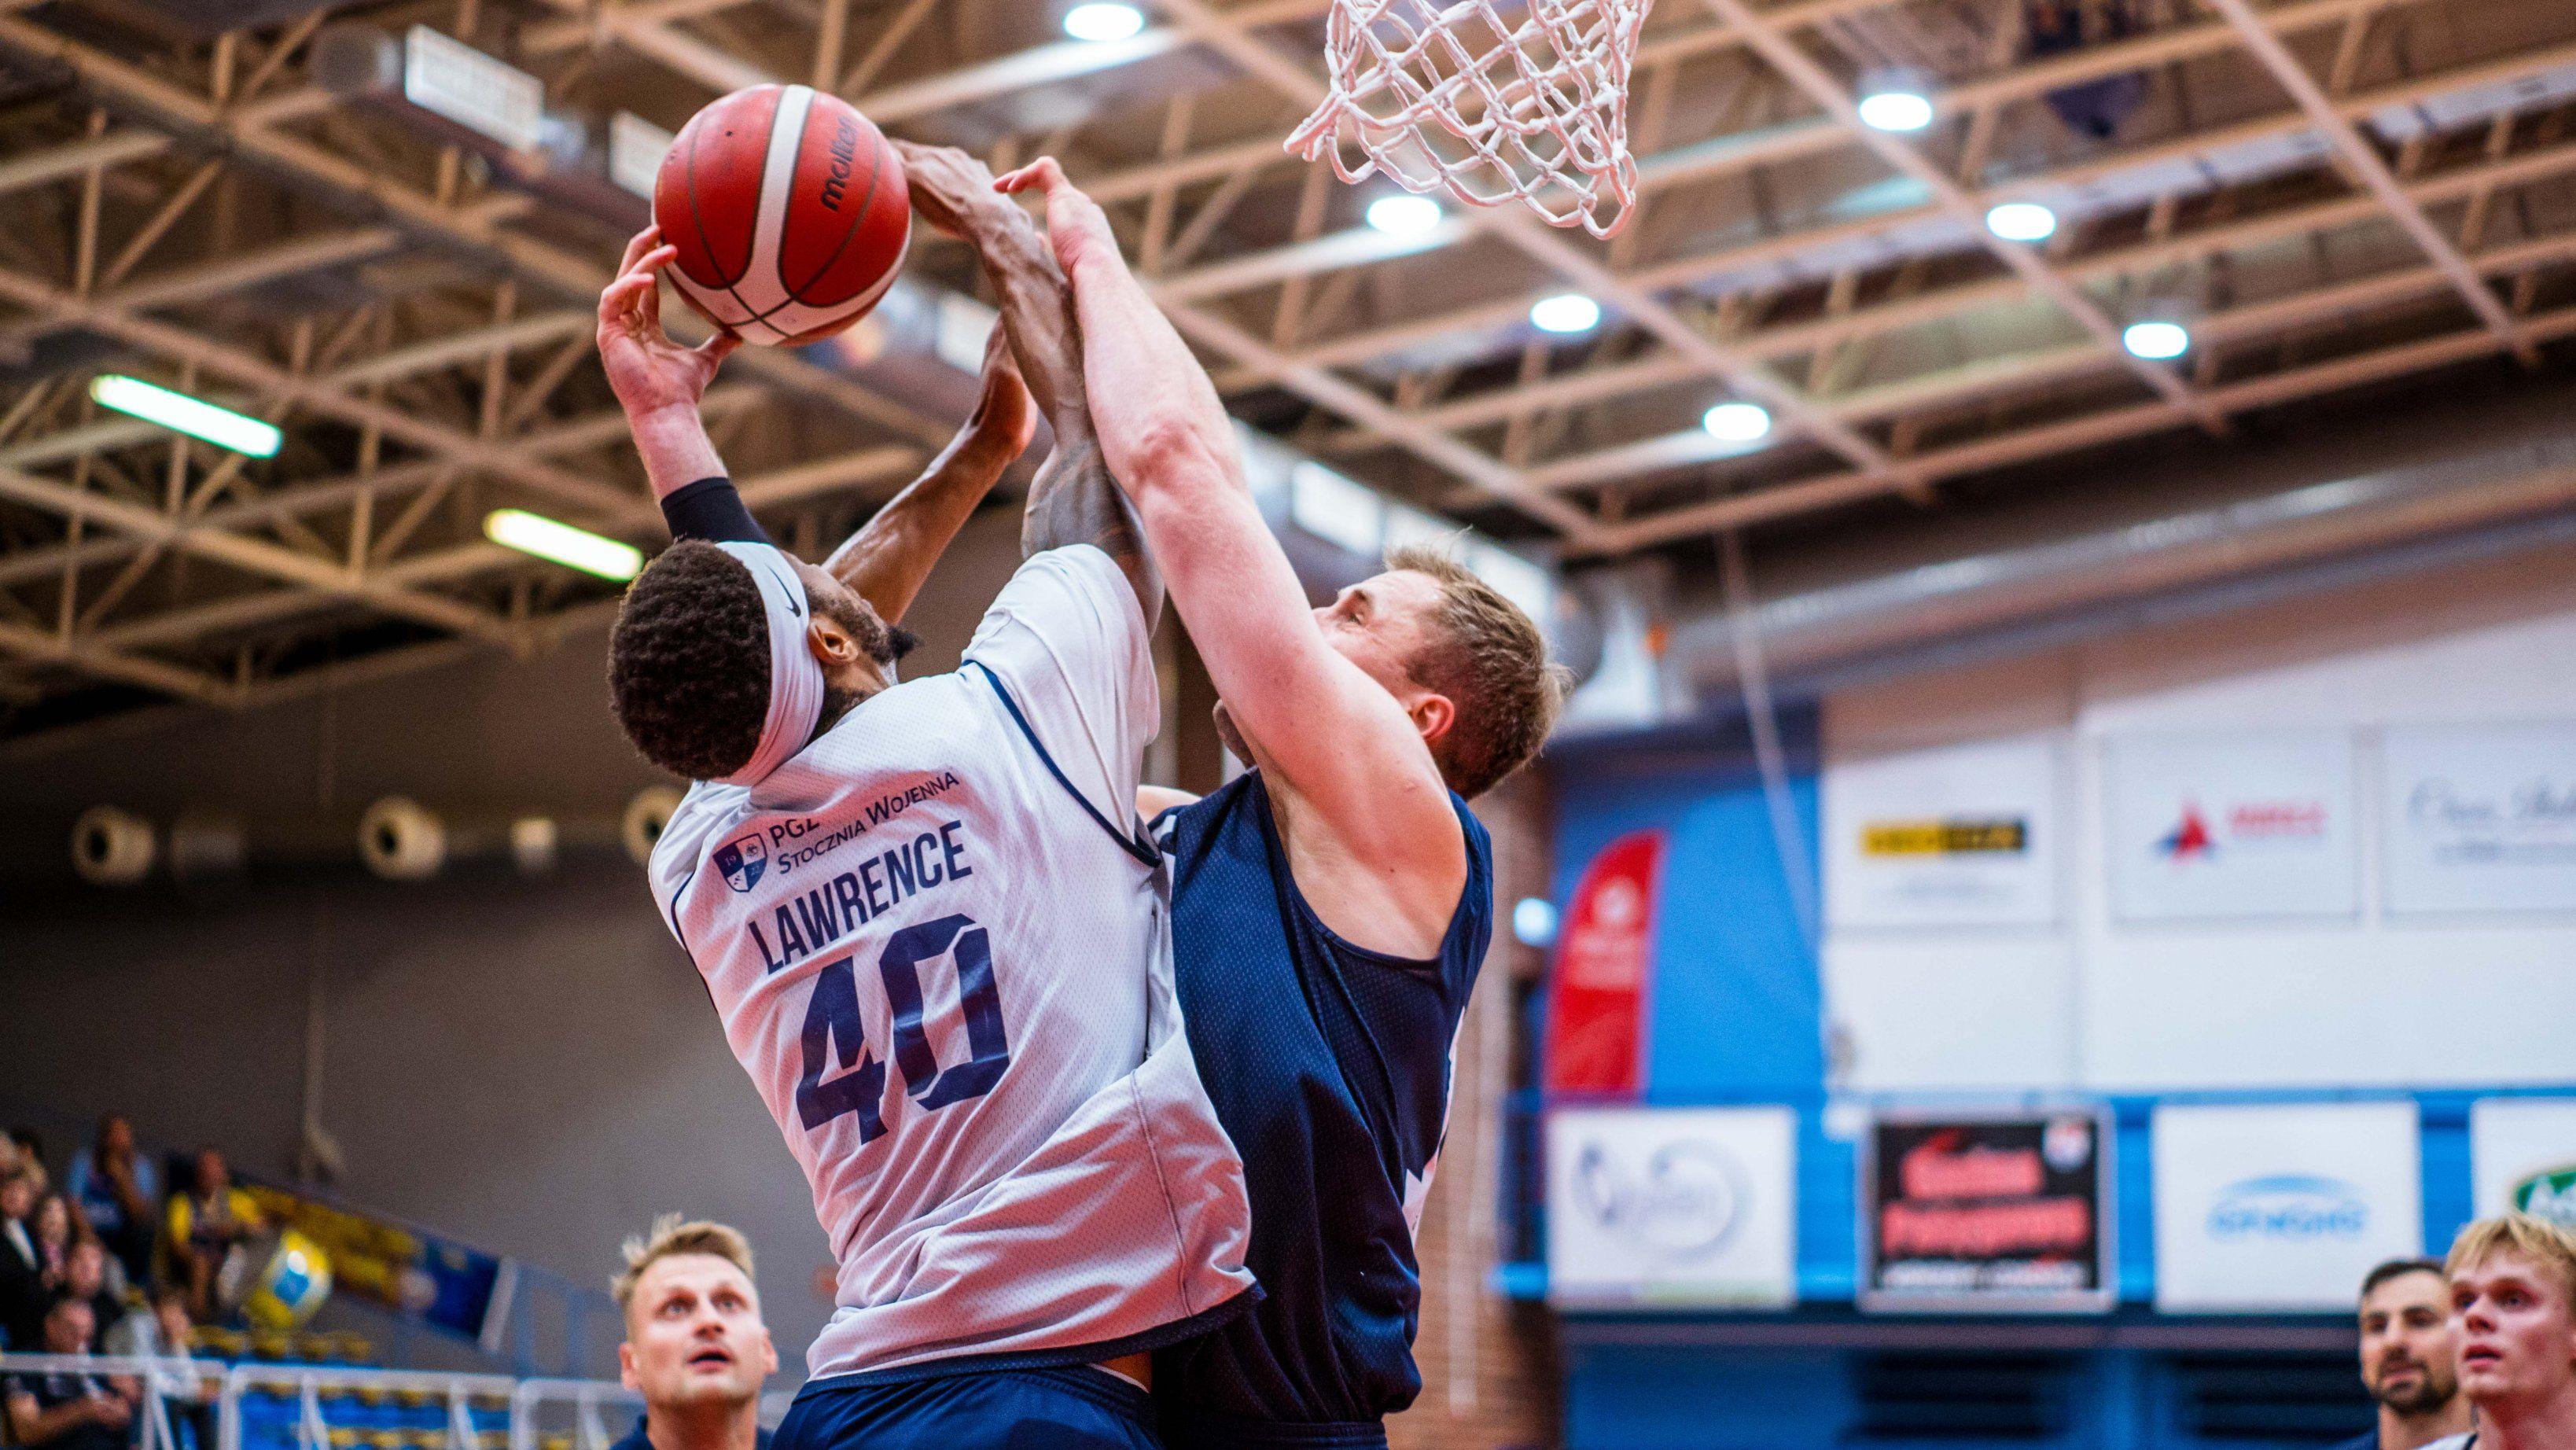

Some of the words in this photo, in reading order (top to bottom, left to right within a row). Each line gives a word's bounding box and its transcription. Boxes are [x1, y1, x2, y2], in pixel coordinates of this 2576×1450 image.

[820, 116, 857, 211] molten
[778, 819, 867, 874] STOCZNIA
[866, 771, 959, 826] WOJENNA
[749, 819, 973, 975] LAWRENCE
[796, 913, 1010, 1146] 40
